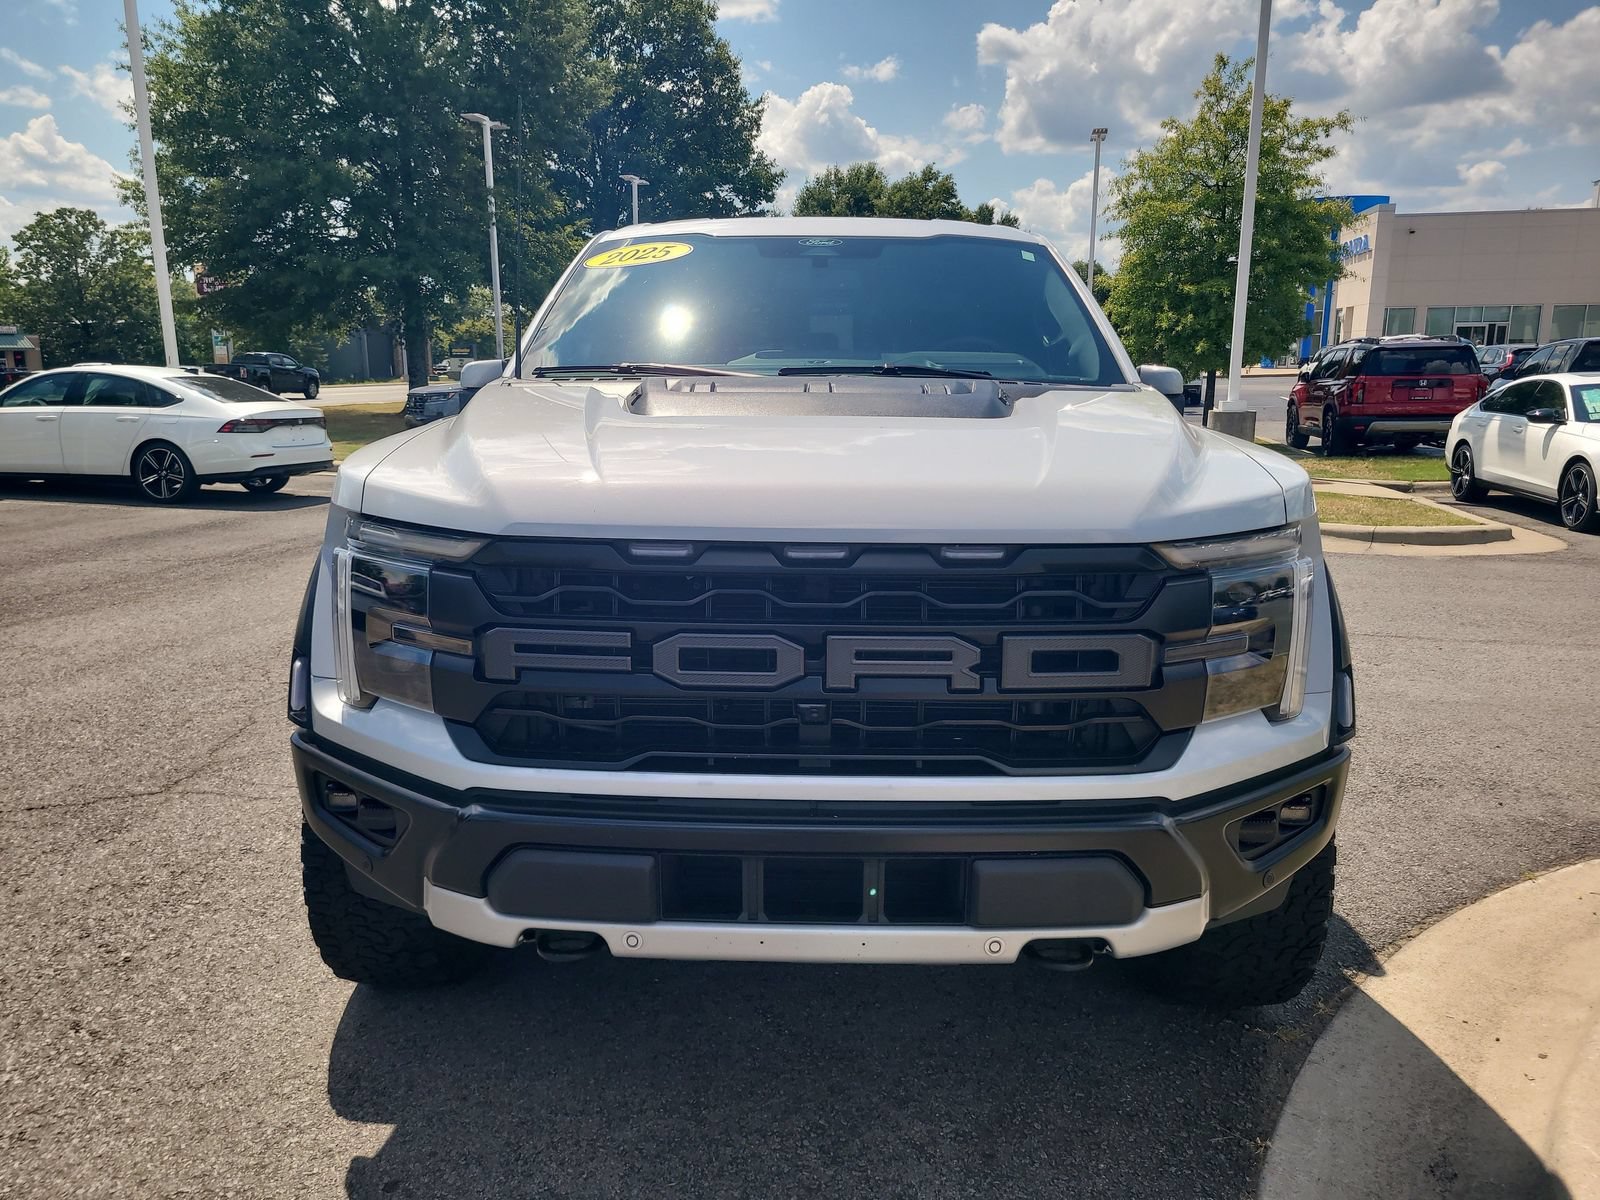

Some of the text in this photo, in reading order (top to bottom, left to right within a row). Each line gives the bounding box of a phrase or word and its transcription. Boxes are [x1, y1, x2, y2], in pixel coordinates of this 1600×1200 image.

[804, 238, 835, 247] Ford
[1338, 234, 1369, 259] ONDA
[600, 245, 677, 266] 2025
[483, 626, 1156, 691] FORD
